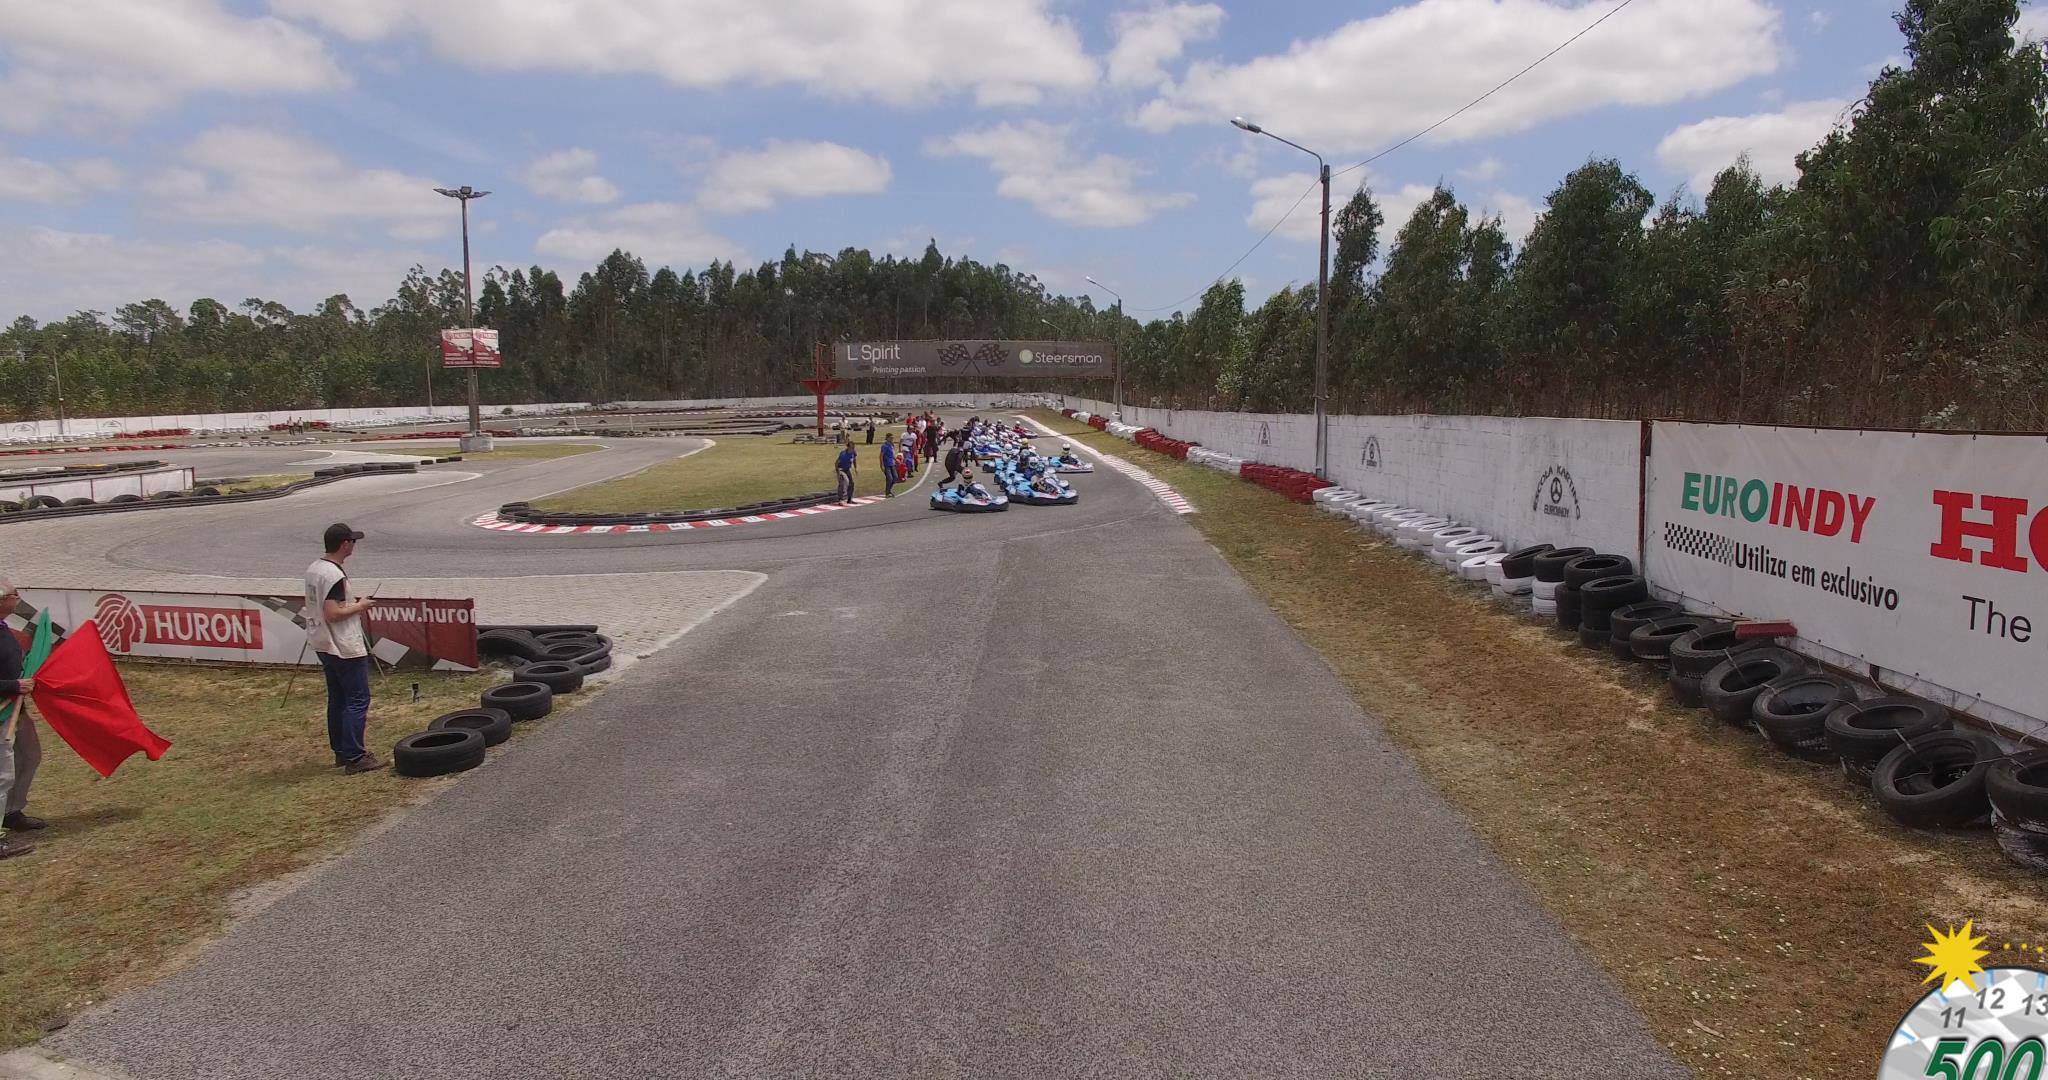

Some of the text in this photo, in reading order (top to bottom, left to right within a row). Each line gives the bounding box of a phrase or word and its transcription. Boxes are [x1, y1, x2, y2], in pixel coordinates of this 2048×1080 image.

[861, 344, 901, 364] Spirit
[1035, 352, 1102, 364] Steersman
[1681, 472, 1876, 544] EUROINDY
[1930, 489, 2048, 574] H
[1735, 542, 1899, 611] Utiliza em exclusivo
[153, 610, 252, 644] HURON
[1962, 595, 2032, 643] The
